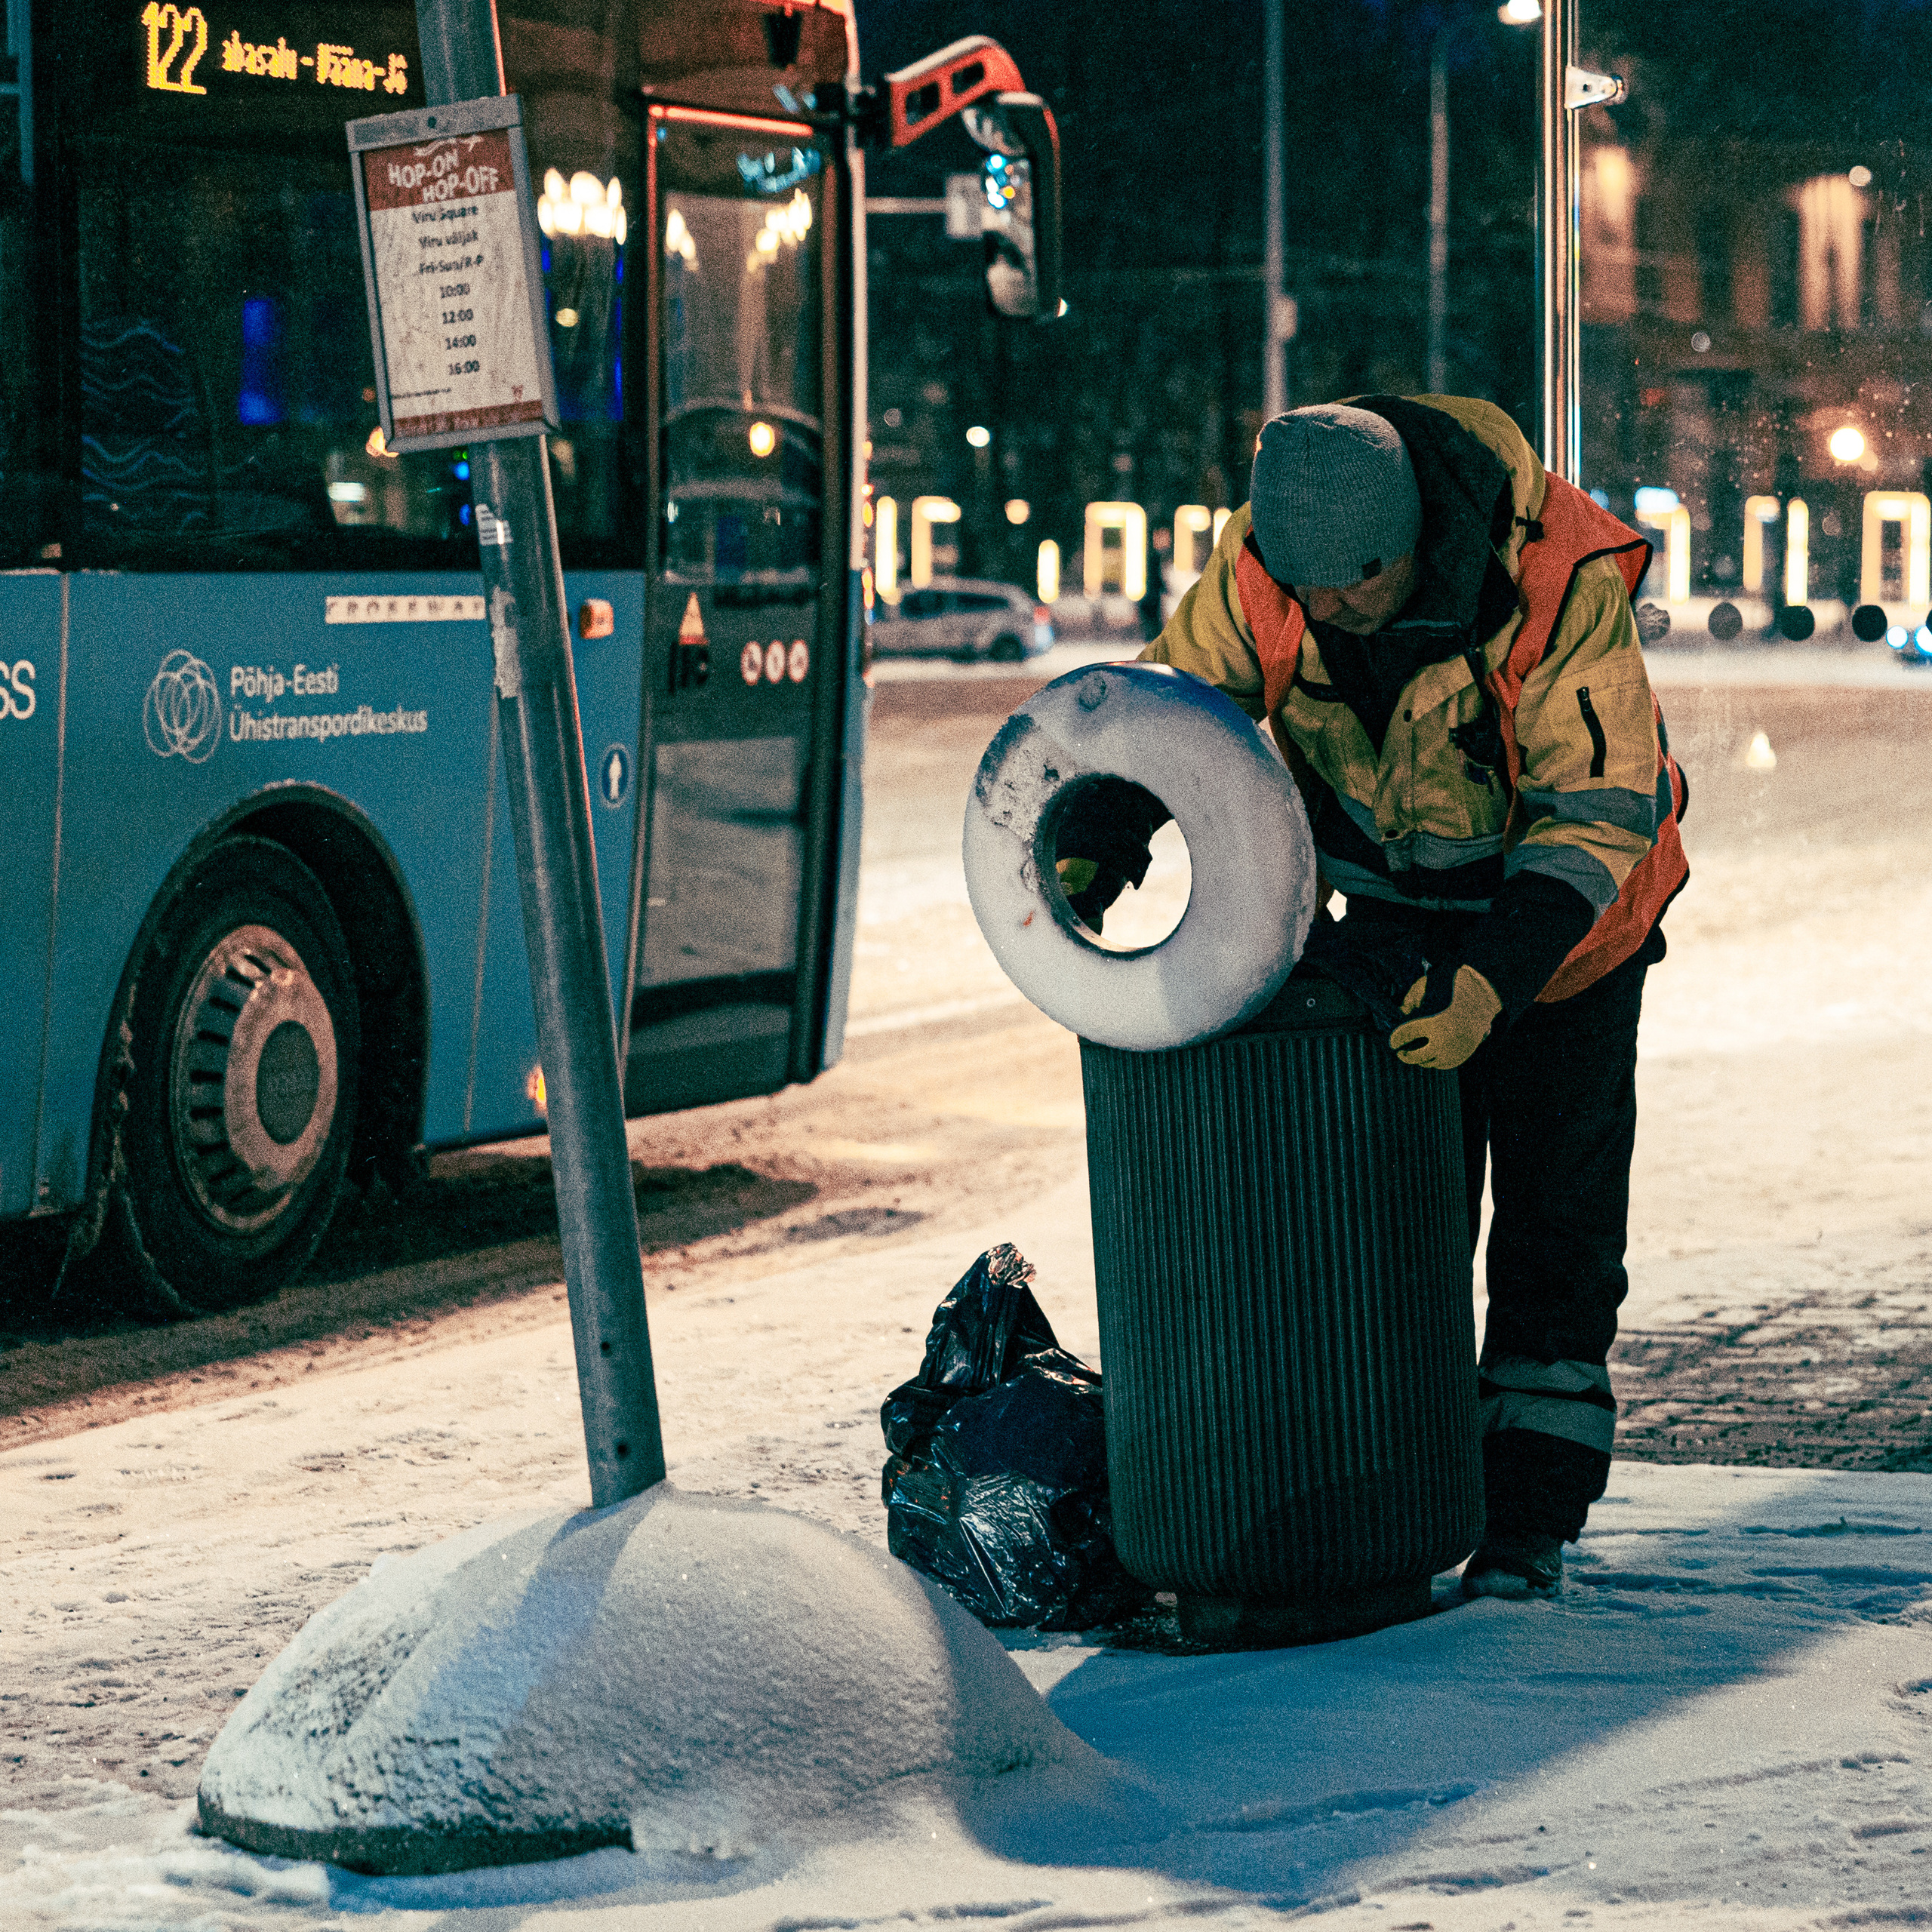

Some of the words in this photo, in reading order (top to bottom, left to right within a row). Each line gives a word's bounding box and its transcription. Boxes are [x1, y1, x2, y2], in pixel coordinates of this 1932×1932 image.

[143, 2, 208, 95] 122
[387, 150, 460, 189] HOP-ON
[422, 166, 500, 203] HOP-OFF
[439, 282, 471, 299] 10:00
[441, 309, 474, 325] 12:00
[445, 334, 477, 350] 14:00
[448, 360, 480, 376] 16:00
